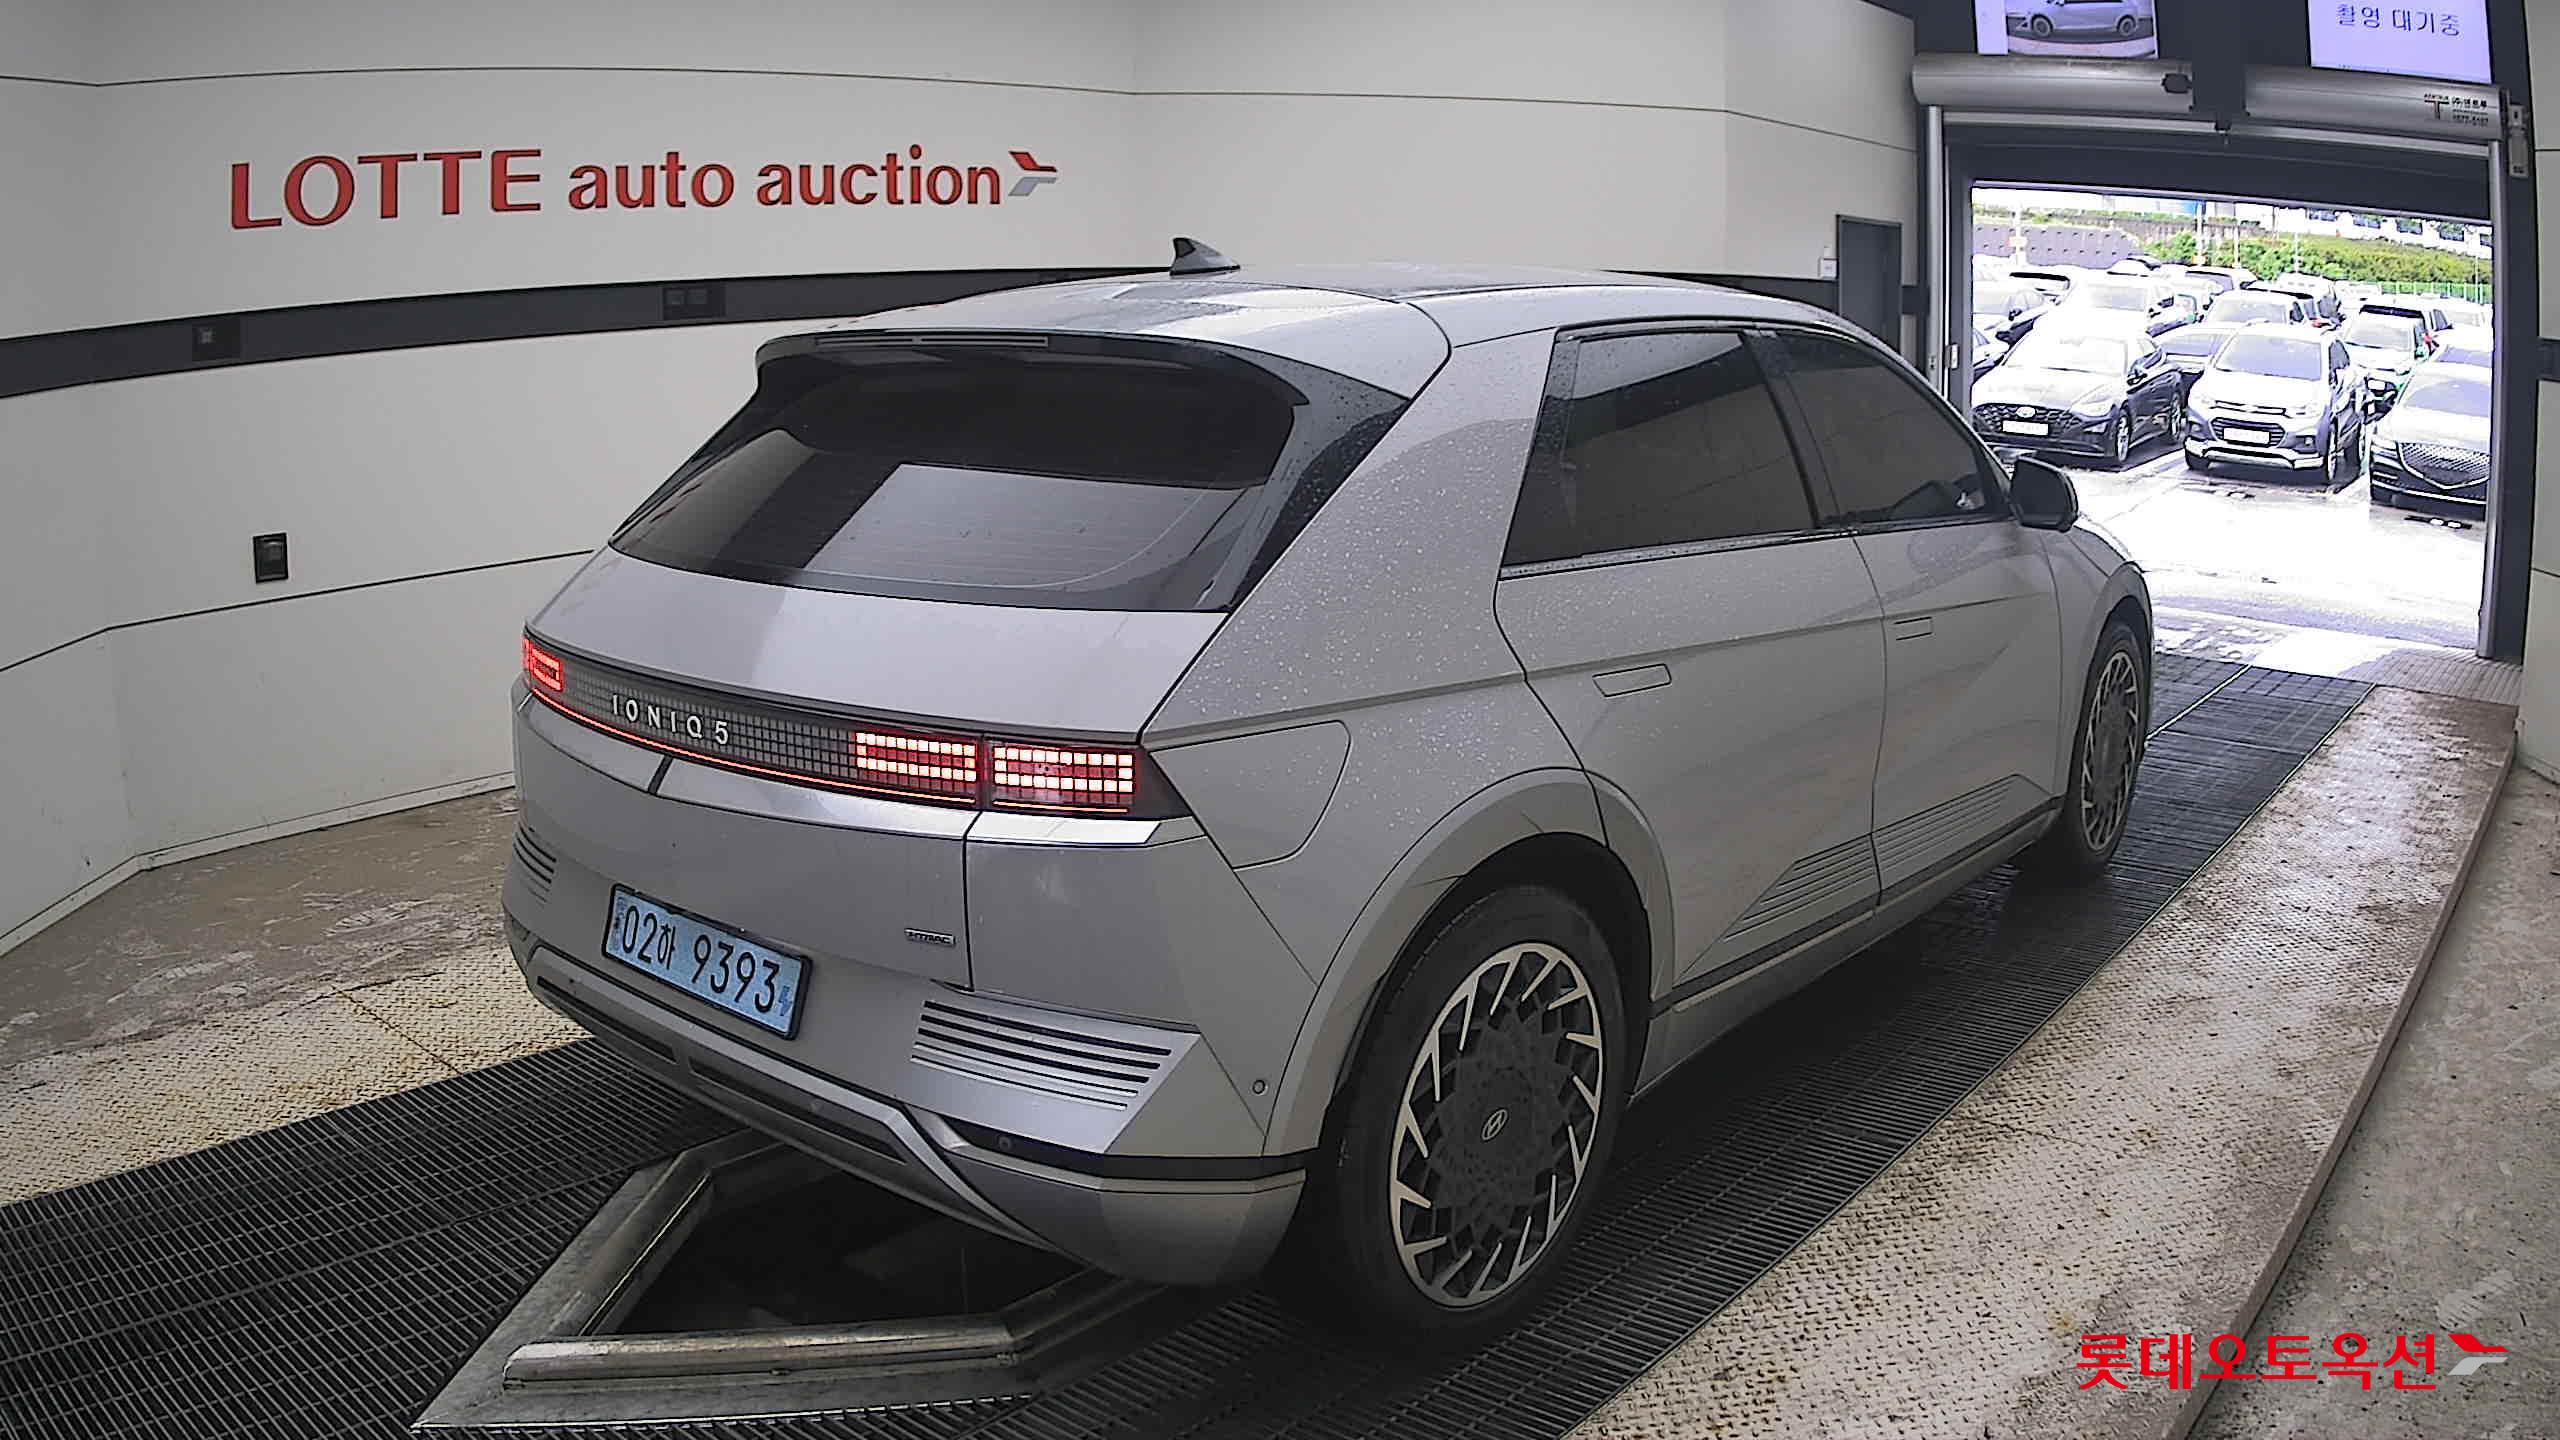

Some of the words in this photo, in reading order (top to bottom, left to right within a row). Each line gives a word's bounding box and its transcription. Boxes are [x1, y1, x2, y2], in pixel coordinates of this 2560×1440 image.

[2337, 3, 2381, 29] 촬영
[2391, 8, 2460, 37] 대기중
[230, 148, 542, 230] LOTTE
[567, 151, 735, 210] auto
[756, 143, 1001, 206] auction
[612, 693, 703, 740] IONIQ
[714, 720, 729, 745] 5
[622, 905, 677, 971] 02하
[691, 933, 781, 1014] 9393
